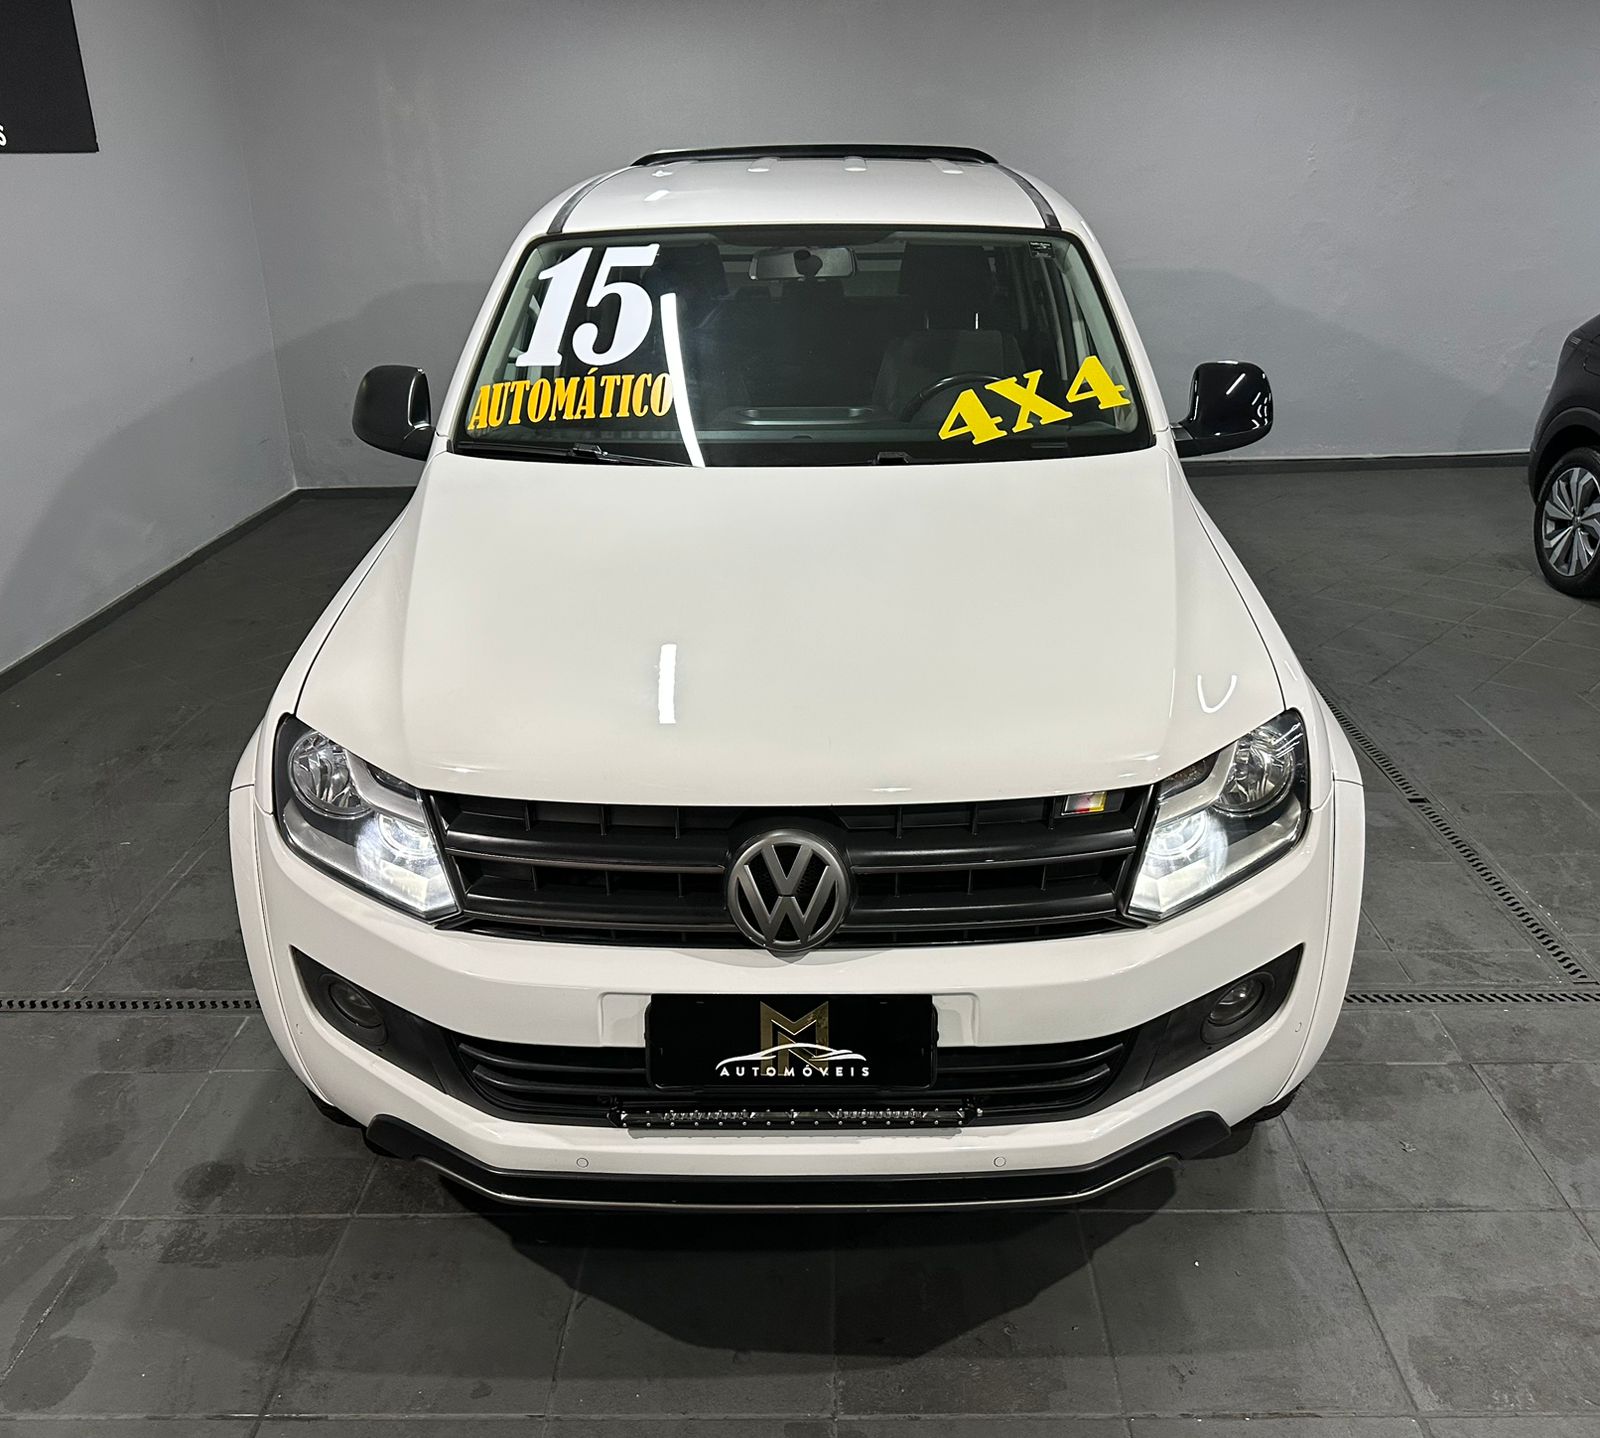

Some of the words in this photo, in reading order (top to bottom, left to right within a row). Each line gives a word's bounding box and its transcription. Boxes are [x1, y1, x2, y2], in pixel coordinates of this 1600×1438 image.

[515, 243, 660, 366] 15
[467, 367, 674, 431] AUTOMÁTICO
[938, 355, 1131, 445] 4X4
[719, 1064, 870, 1077] AUTOMÓVEIS
